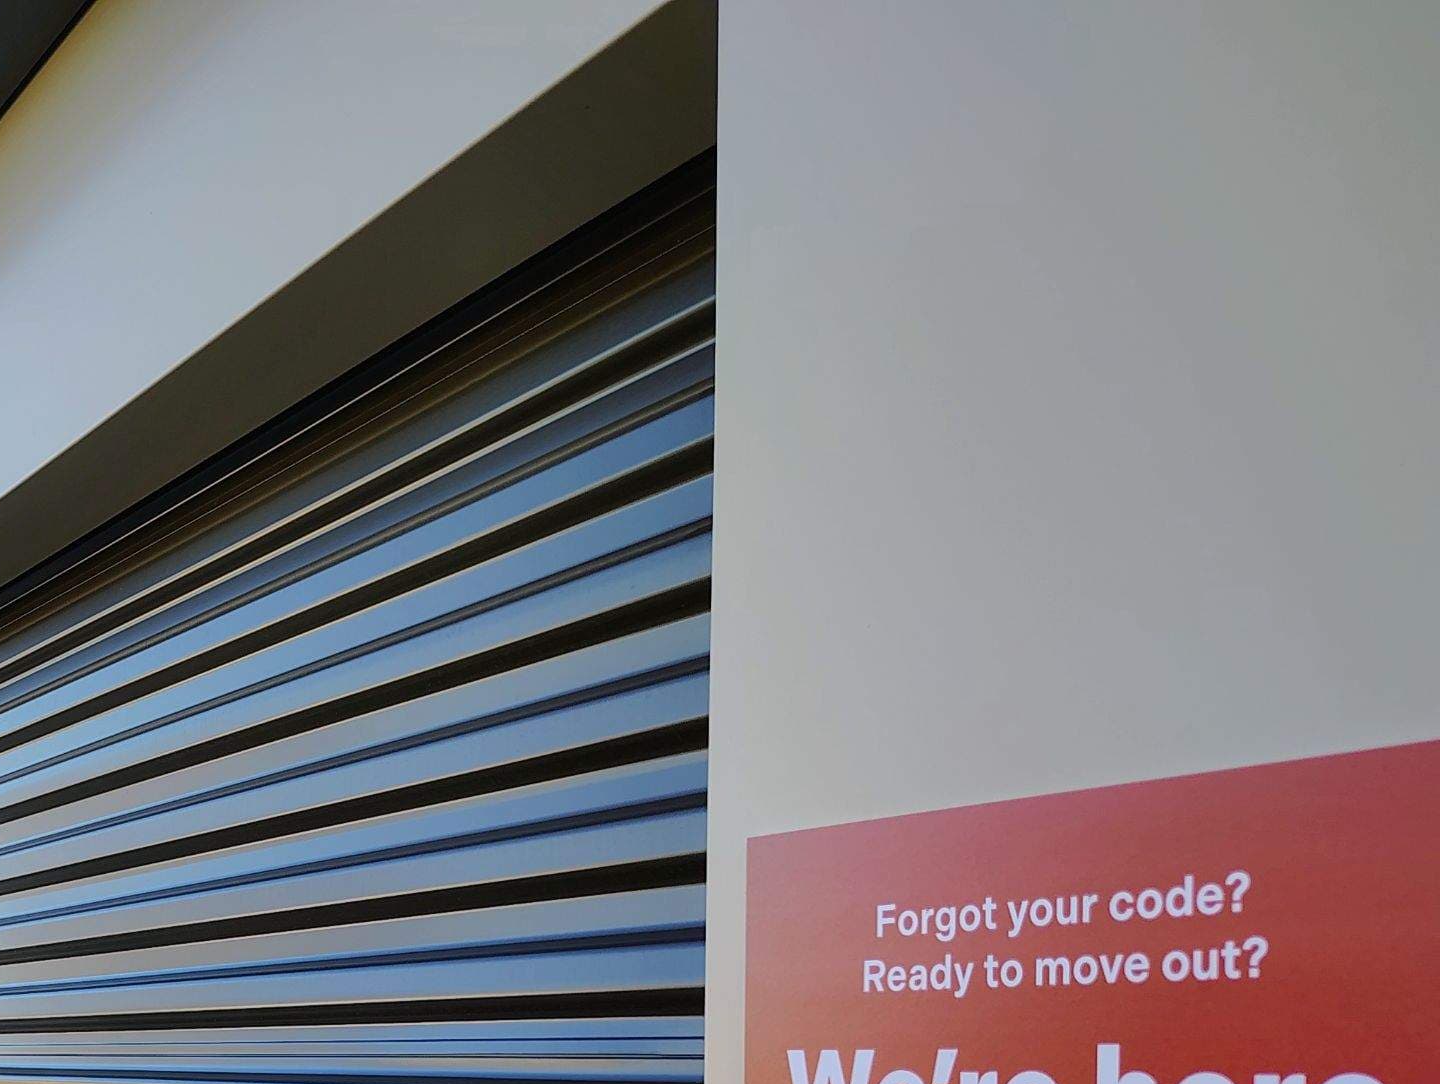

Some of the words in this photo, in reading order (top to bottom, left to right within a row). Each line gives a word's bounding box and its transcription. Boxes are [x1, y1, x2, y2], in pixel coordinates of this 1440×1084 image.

[875, 896, 998, 942] Forgot
[1006, 893, 1099, 938] your
[1109, 871, 1252, 924] code?
[862, 953, 975, 999] Ready
[983, 954, 1024, 990] to
[1035, 951, 1150, 988] move
[1161, 936, 1270, 983] out?
